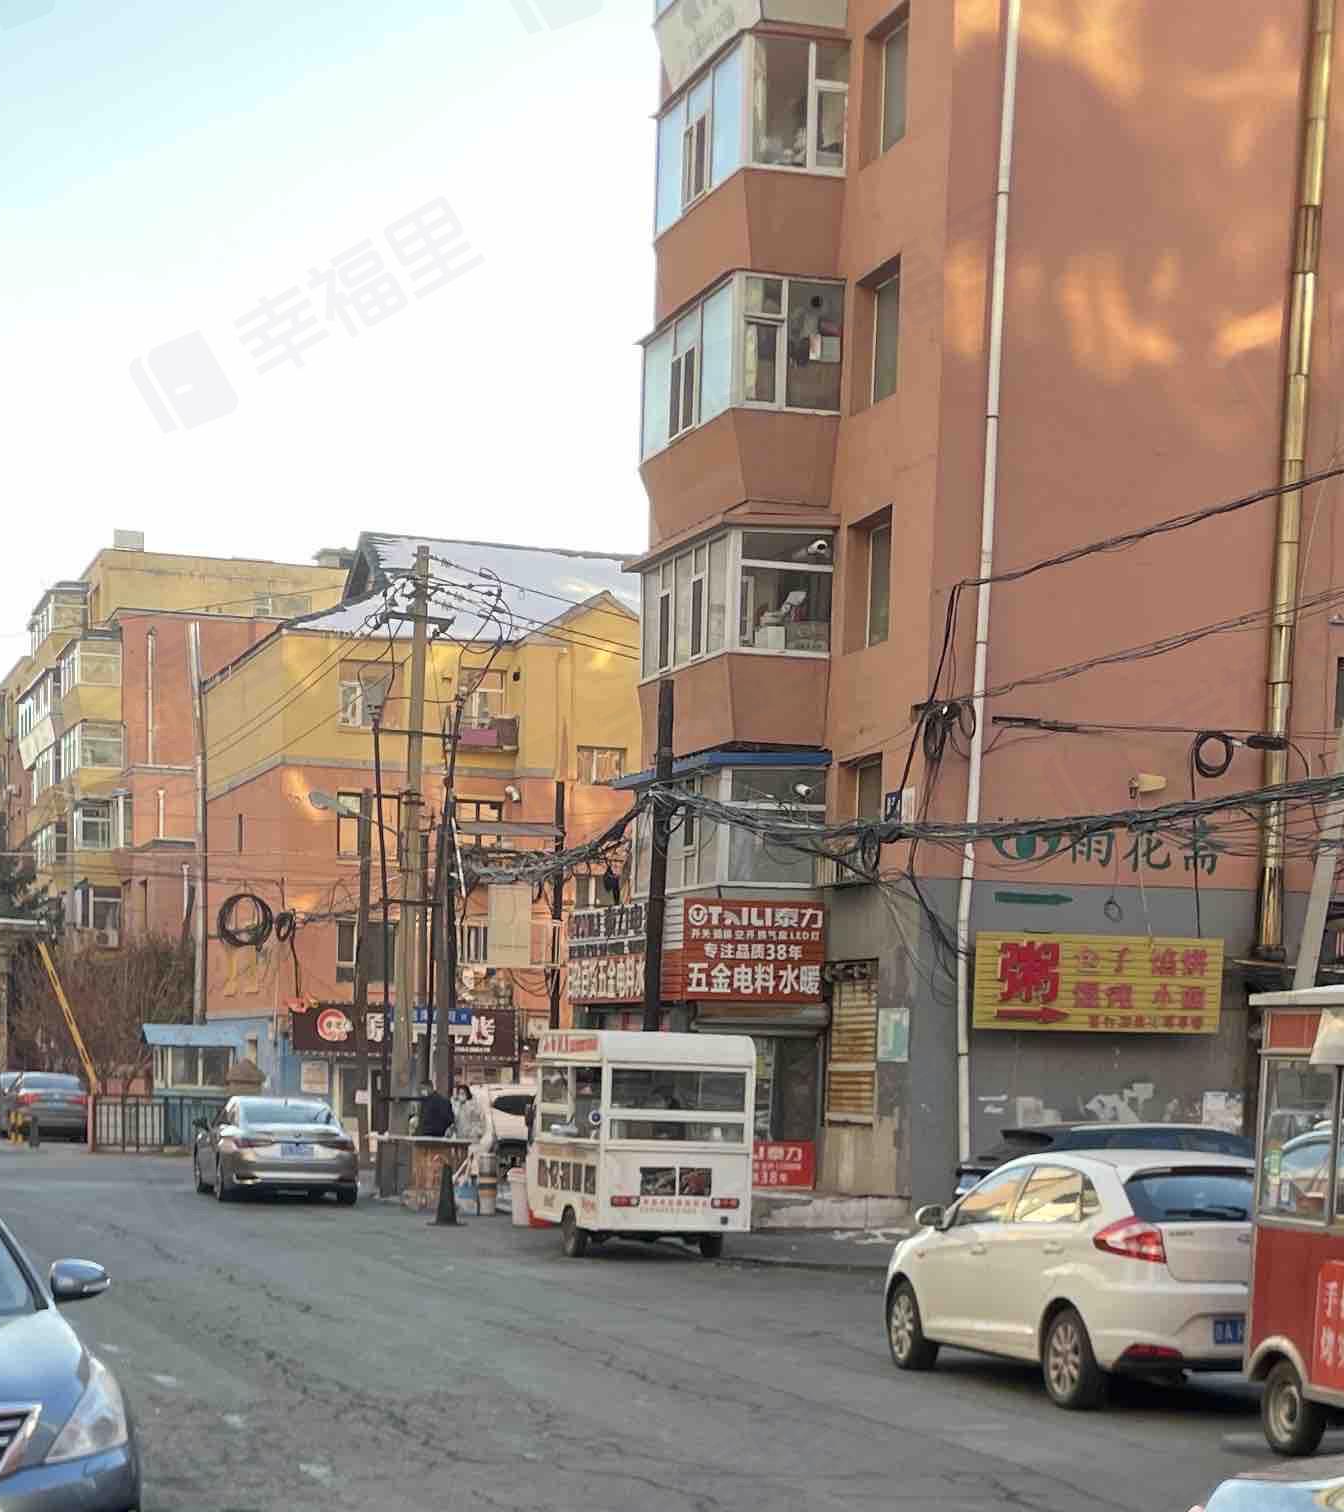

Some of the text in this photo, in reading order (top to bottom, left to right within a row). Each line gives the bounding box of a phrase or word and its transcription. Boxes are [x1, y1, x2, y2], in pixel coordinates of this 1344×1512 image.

[703, 941, 803, 961] 专注品质38年
[687, 961, 822, 996] 五金电料水暖
